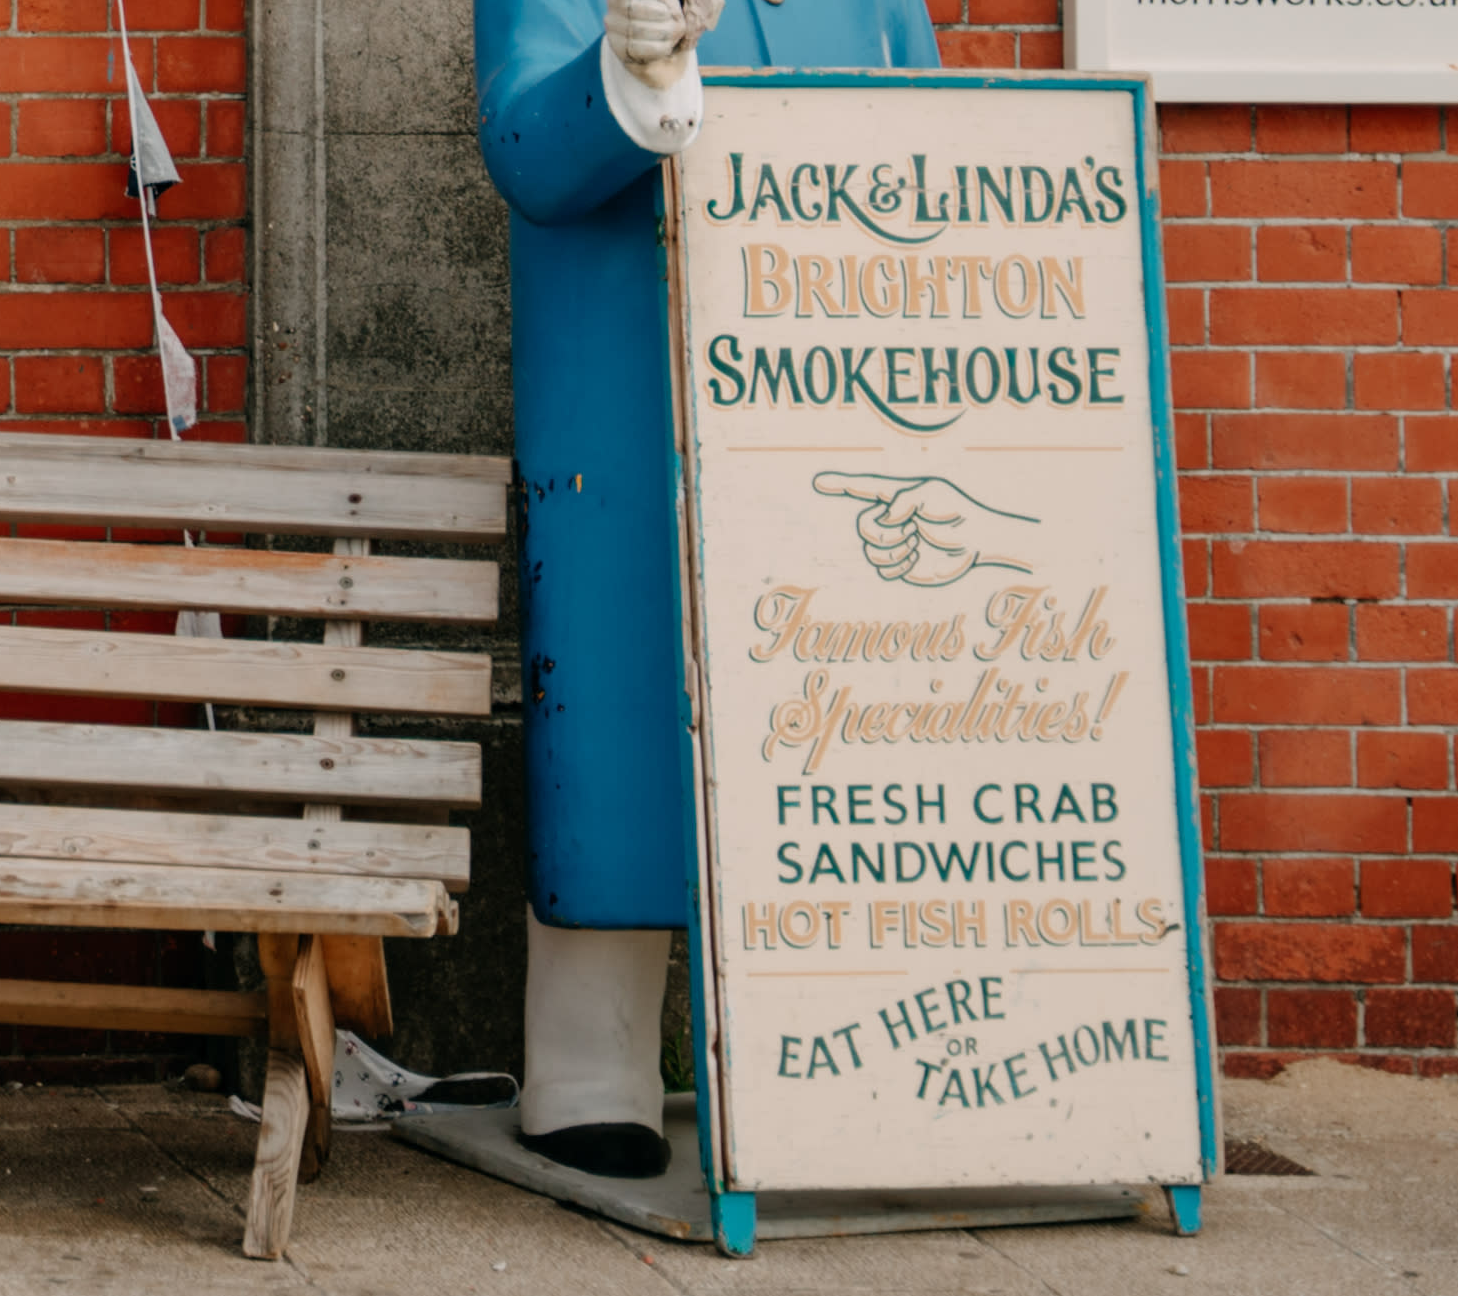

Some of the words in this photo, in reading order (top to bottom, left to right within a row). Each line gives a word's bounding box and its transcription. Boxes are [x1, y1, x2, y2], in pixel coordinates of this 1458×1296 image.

[741, 243, 1085, 319] BRIGHTON
[705, 335, 1124, 437] SMOKEHOUSE
[749, 584, 967, 663] Famous
[974, 584, 1119, 662] Fish
[762, 667, 1128, 775] Specialities!
[777, 784, 946, 825] FRESH
[973, 783, 1119, 823] CRAB
[777, 840, 1126, 883] SANDWICHES
[743, 900, 850, 949] HOT
[869, 899, 986, 948] FISH
[1005, 898, 1166, 946] ROLLS
[777, 1022, 865, 1079] EAT
[878, 976, 1006, 1048] HERE
[913, 1052, 1038, 1108] TAKE
[1039, 1017, 1170, 1082] HOME
[946, 1036, 978, 1057] OR
